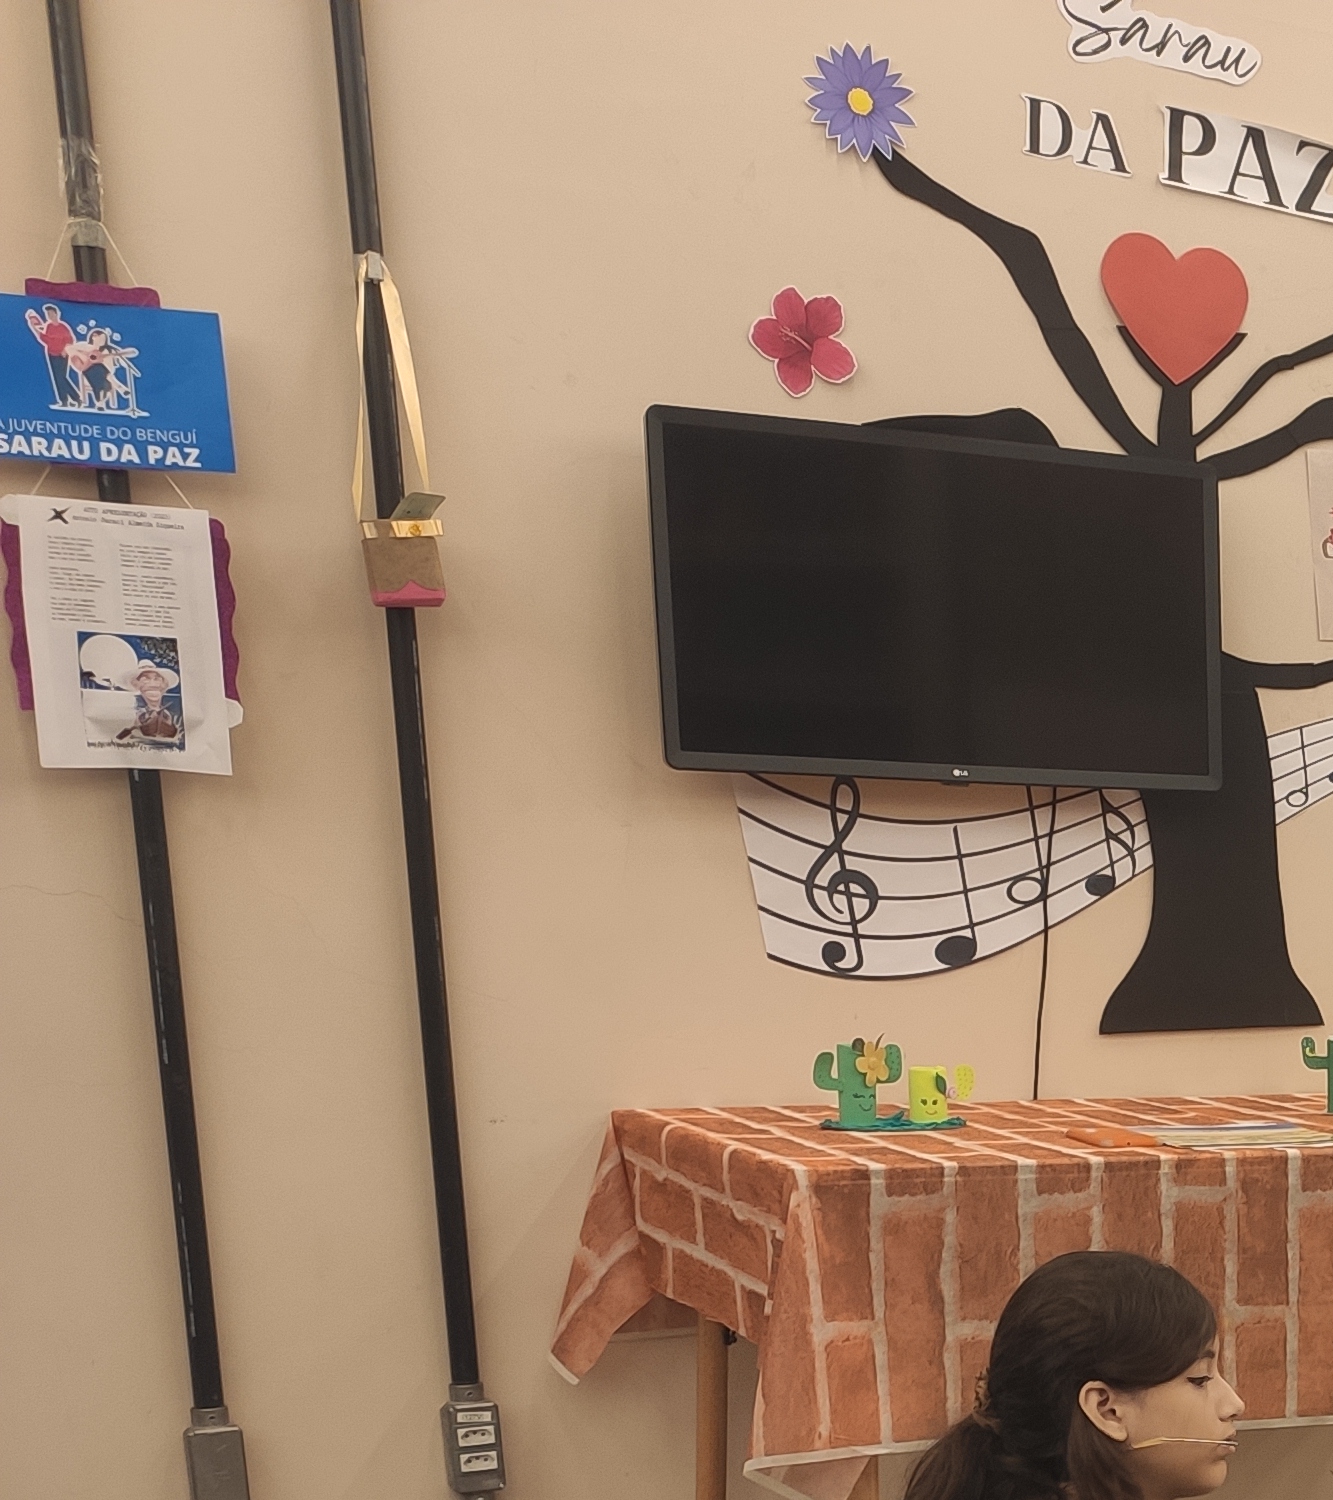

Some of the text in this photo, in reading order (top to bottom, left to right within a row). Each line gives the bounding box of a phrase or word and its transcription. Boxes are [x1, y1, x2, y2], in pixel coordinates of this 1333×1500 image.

[1062, 0, 1258, 79] Sarau
[1023, 96, 1131, 175] DA
[0, 433, 202, 468] SARAU DA PAZ
[8, 418, 102, 439] JUVENTUDE
[107, 426, 131, 441] DO
[136, 428, 197, 445] BENGUÍ
